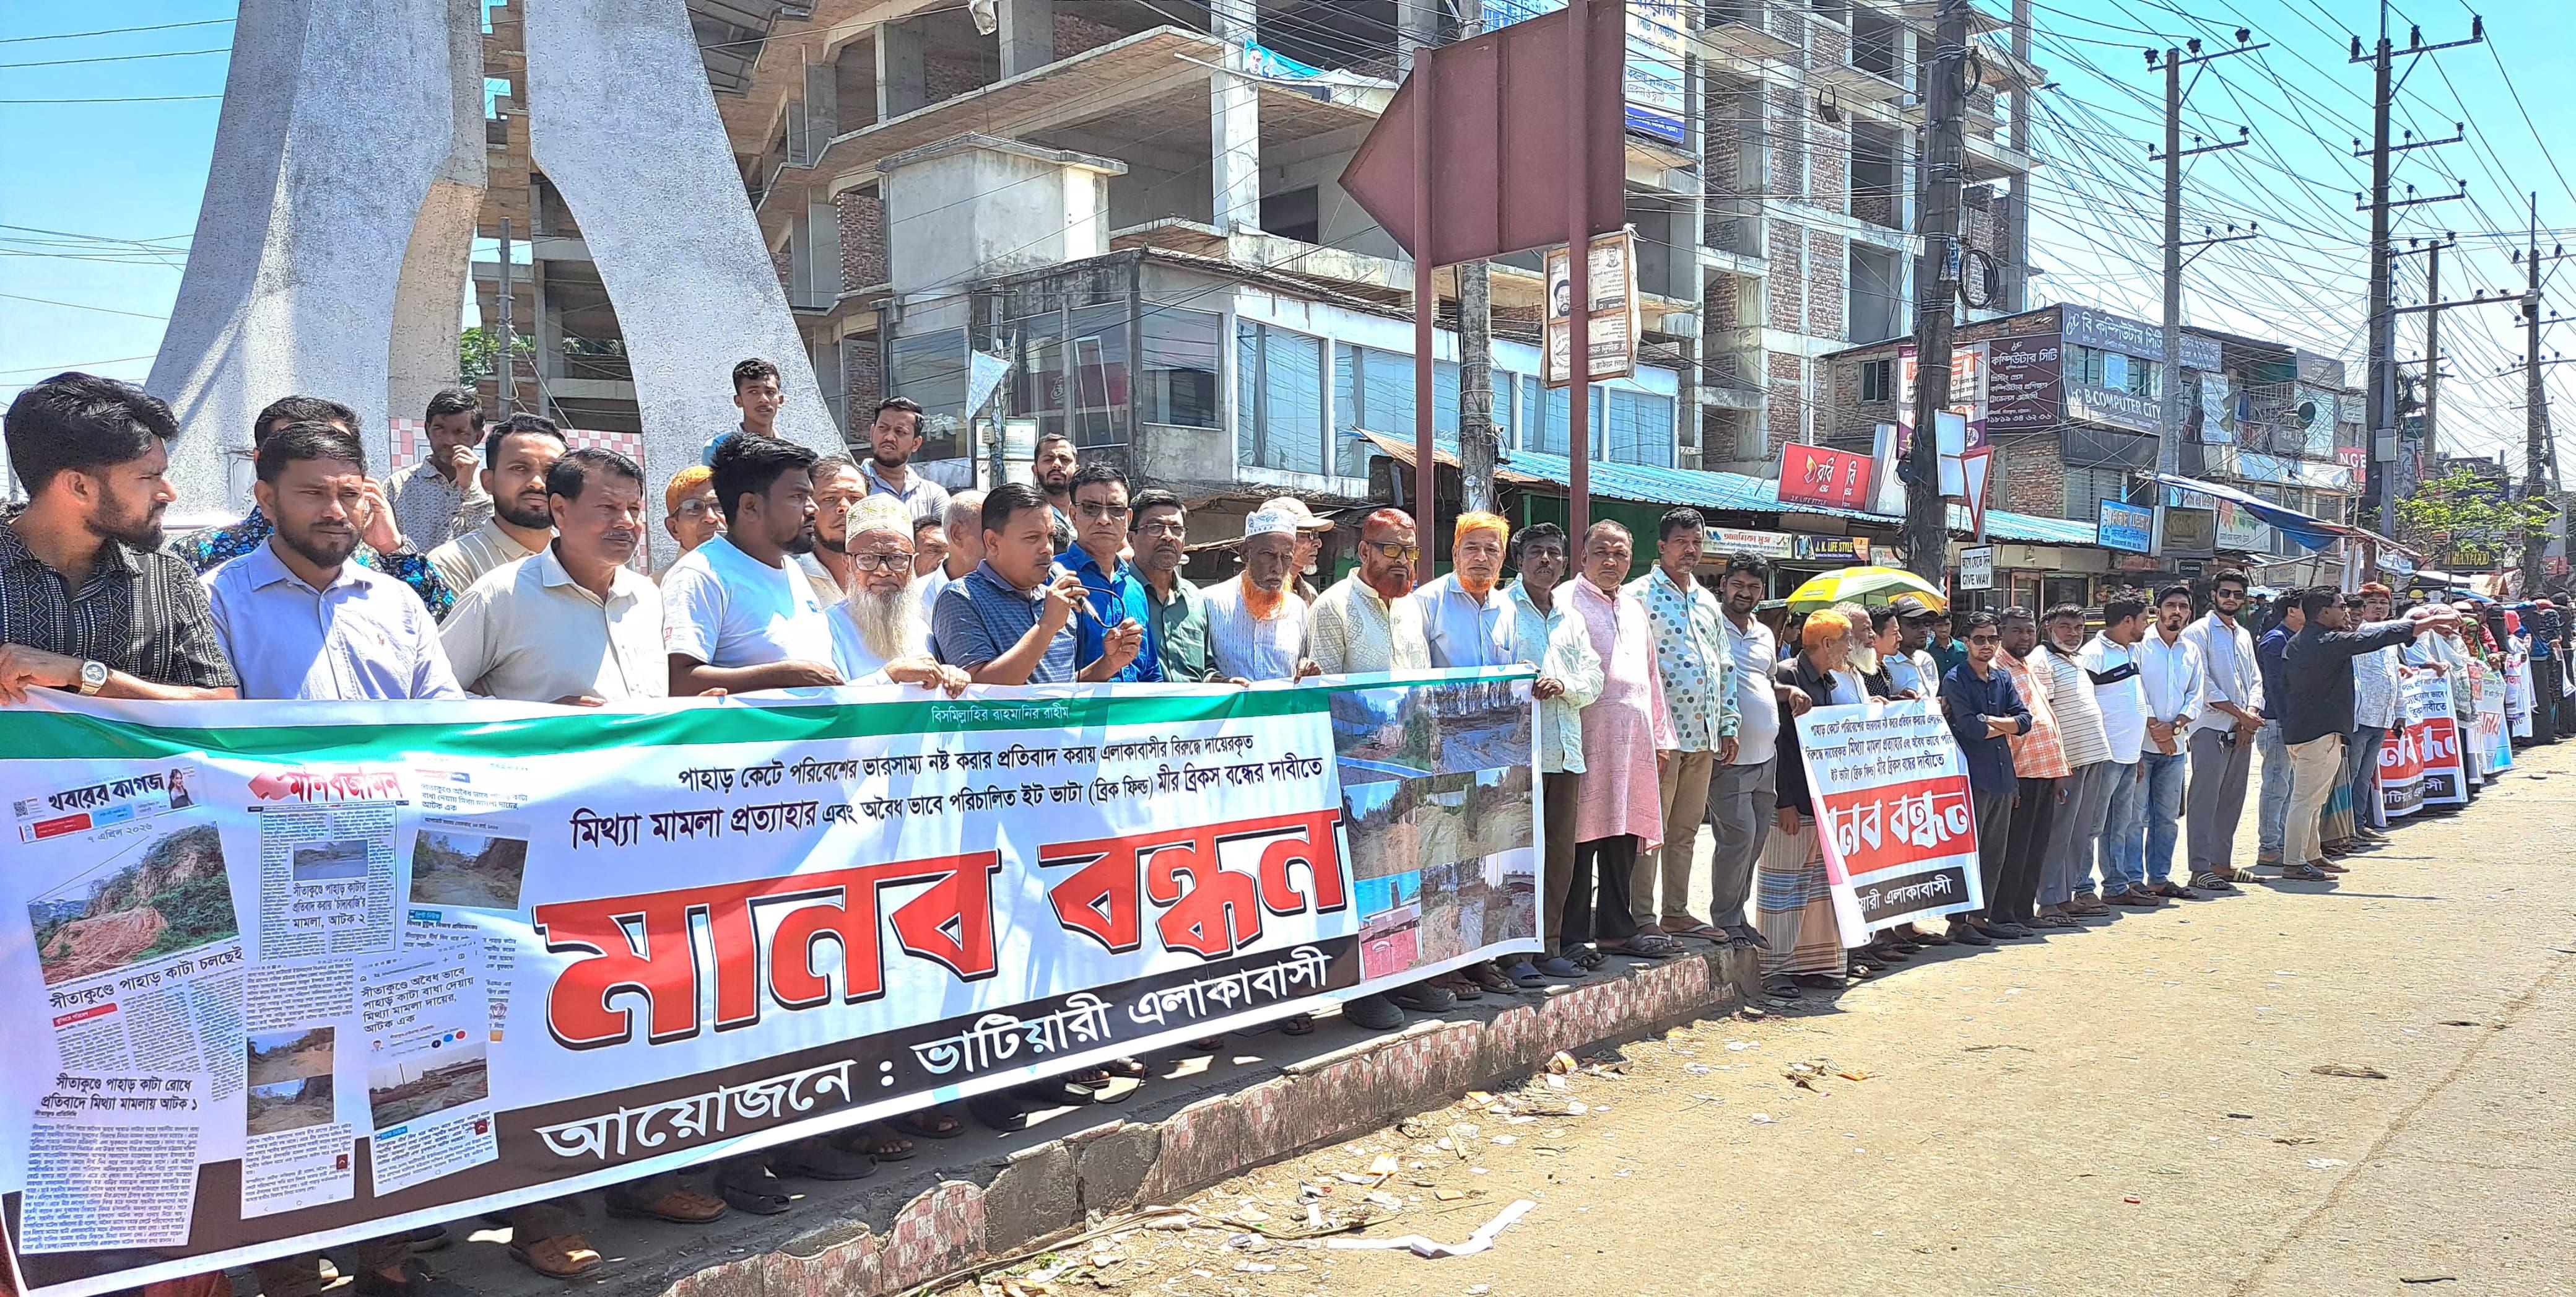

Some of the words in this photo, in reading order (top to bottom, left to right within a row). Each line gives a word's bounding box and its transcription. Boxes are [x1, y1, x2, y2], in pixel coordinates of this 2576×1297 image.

[2081, 311, 2092, 334] বি
[1991, 351, 2037, 365] কম্পিউটার
[2039, 347, 2058, 362] সিটি
[2084, 390, 2092, 403] B
[2093, 391, 2143, 416] COMPUTER
[2143, 403, 2162, 419] CITY
[2025, 414, 2037, 422] ৬২
[1816, 457, 1835, 483] রবি
[1815, 541, 1820, 552] J.
[1821, 541, 1827, 552] K.
[1827, 541, 1838, 552] LIFE
[1838, 541, 1853, 552] STYLE
[1962, 574, 1975, 585] GIVE
[1975, 573, 1990, 585] WAY
[931, 705, 989, 725] বিসমিল্লাহির
[992, 705, 1039, 723] রাহমানির
[1043, 705, 1069, 720] রাহীম
[1810, 723, 1826, 738] পাহাড়
[1827, 721, 1840, 735] কেটে
[1841, 718, 1865, 734] পরিবেশের
[1805, 746, 1824, 762] বিরুদ্ধে
[1847, 737, 1865, 756] মিথ্যা
[1866, 738, 1882, 754] মামলা
[1882, 736, 1903, 753] প্রত্যাহার
[1912, 735, 1925, 748] অবৈধ
[1925, 735, 1939, 746] ভাবে
[678, 766, 734, 795] পাহাড়
[742, 758, 785, 790] কেটে
[789, 756, 858, 786] পরিবেশের
[863, 754, 923, 780] ভারসাম্য
[928, 748, 950, 769] নষ্ট
[955, 749, 993, 771] করার
[998, 744, 1058, 769] প্রতিবাদ
[1063, 746, 1097, 767] করায়
[1100, 736, 1168, 763] এলাকাবাসীর
[1170, 736, 1201, 759] বিরুদ্ধে
[1204, 735, 1254, 759] দায়েরকৃত
[1830, 767, 1838, 782] ইট
[1838, 766, 1850, 781] ভাটা
[1877, 756, 1887, 775] মীর
[1887, 756, 1901, 775] ব্রিকস
[1917, 749, 1944, 770] দাবীতে
[48, 784, 111, 811] খবরের
[110, 772, 165, 800] কাগজ
[569, 807, 643, 850] মিথ্যা
[648, 804, 724, 844] মামলা
[730, 799, 819, 837] প্রত্যাহার
[822, 803, 857, 825] এবং
[860, 797, 904, 821] অবৈধ
[908, 795, 943, 816] ভাবে
[949, 785, 1017, 813] পরিচালিত
[1020, 780, 1043, 805] ইট
[1049, 779, 1084, 803] ভাটা
[1087, 779, 1120, 806] (ব্রিক
[1123, 776, 1154, 800] ফিল্ড)
[1157, 764, 1180, 795] মীর
[1184, 762, 1221, 793] ব্রিকস
[1225, 762, 1264, 788] বন্ধের
[1268, 754, 1323, 782] দাবীতে
[97, 828, 124, 842] এপ্রিল
[1827, 798, 1883, 857] ানব
[293, 882, 323, 898] সীতাকুণ্ডে
[325, 883, 347, 897] পাহাড়
[347, 881, 367, 894] কাটার
[1884, 874, 1954, 906] এলাকাবাসী
[293, 899, 315, 913] প্রতিবাদ
[317, 901, 333, 911] করায়
[293, 917, 325, 930] মামলা,
[328, 912, 355, 927] আটক
[359, 913, 367, 923] ২
[531, 849, 1002, 1051] মানব
[1037, 806, 1346, 961] বন্ধন
[50, 984, 115, 1010] সীতাকুণ্ডে
[119, 971, 162, 992] পাহাড়
[164, 960, 196, 980] কাটা
[198, 945, 245, 970] চলছেই
[360, 979, 408, 998] সীতাকুণ্ডে
[410, 972, 440, 987] অবৈধ
[442, 967, 466, 979] ভাবে
[362, 995, 394, 1010] পাহাড়
[396, 989, 420, 1002] কাটা
[422, 984, 443, 996] বাধা
[362, 1008, 389, 1024] মিথ্যা
[391, 1000, 422, 1015] মামলা
[363, 1020, 394, 1034] আটক
[396, 1014, 416, 1026] এক
[533, 1059, 858, 1161] আয়োজনে
[909, 997, 1114, 1073] ভাটিয়ারী
[1128, 945, 1333, 1027] এলাকাবাসী
[55, 1072, 102, 1094] সীতাকুণ্ডে
[105, 1077, 137, 1094] পাহাড়
[139, 1075, 162, 1092] কাটা
[165, 1079, 193, 1093] রোধে
[40, 1092, 87, 1110] প্রতিবাদে
[89, 1093, 118, 1111] মিথ্যা
[120, 1097, 158, 1111] মামলায়
[160, 1094, 189, 1111] আটক
[191, 1100, 198, 1111] ১
